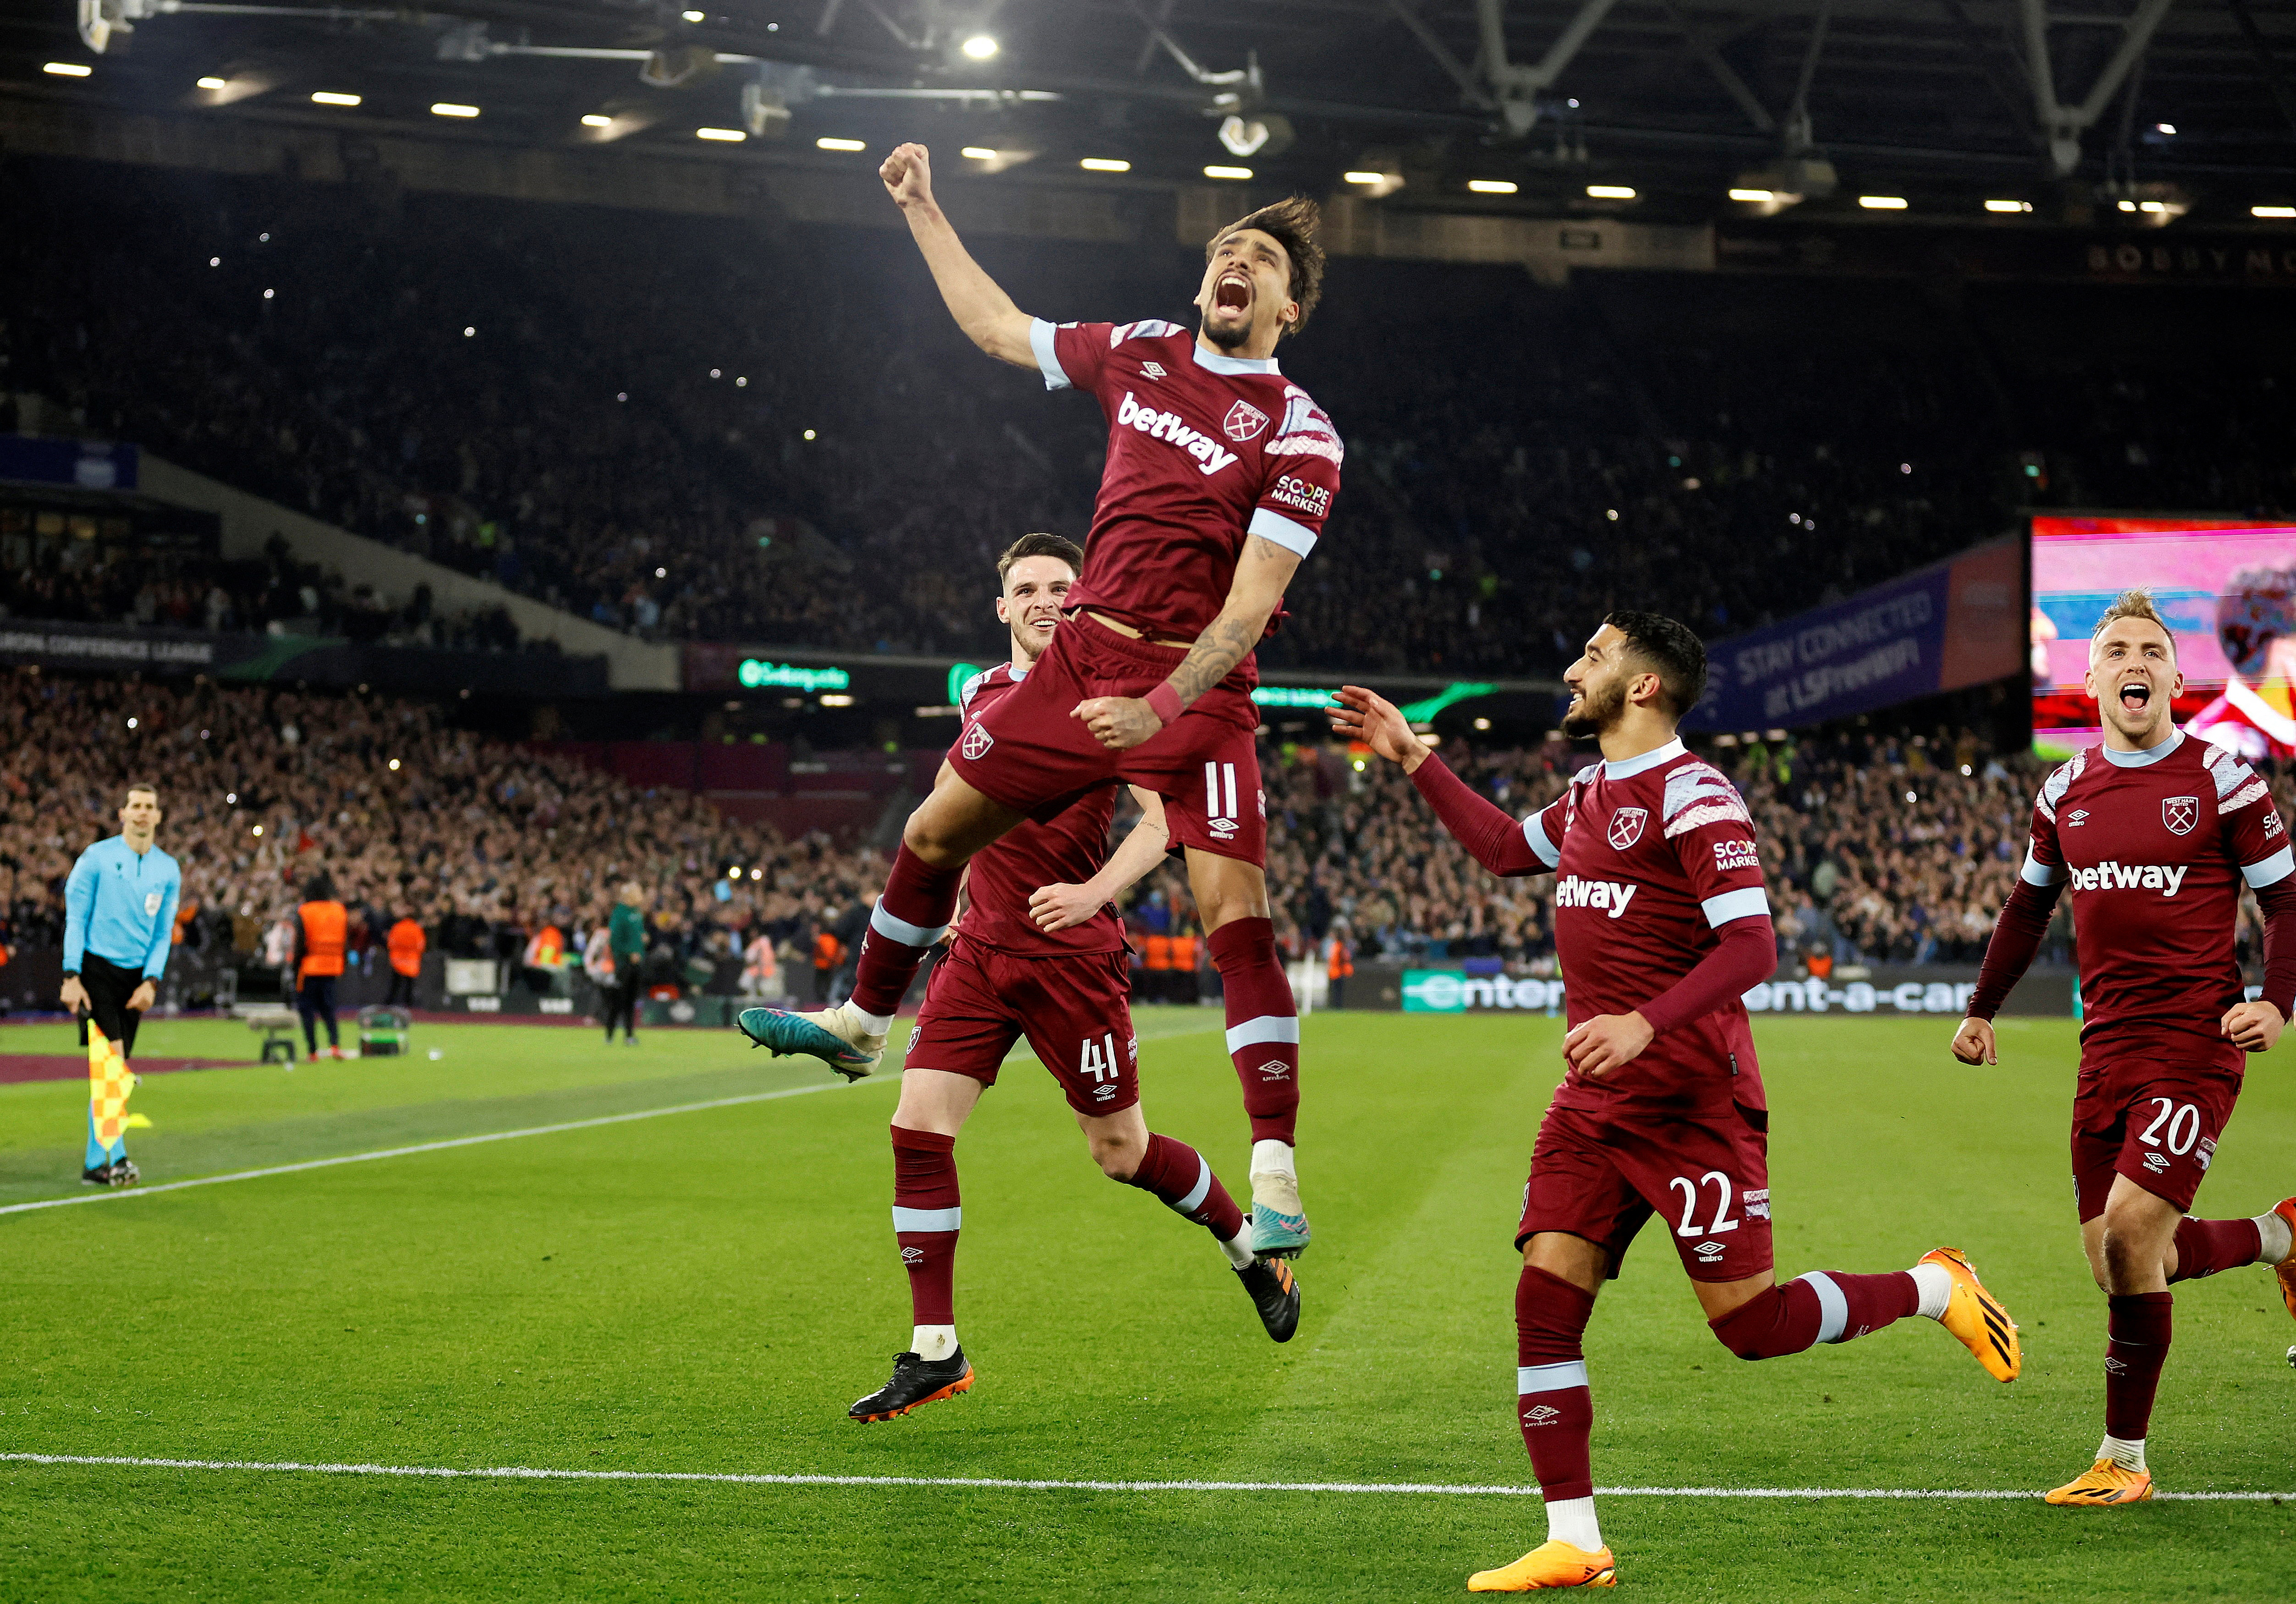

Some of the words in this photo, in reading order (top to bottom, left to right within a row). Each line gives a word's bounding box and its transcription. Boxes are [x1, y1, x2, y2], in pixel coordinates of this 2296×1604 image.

[1118, 391, 1239, 475] betway
[1271, 489, 1324, 516] MARKETS
[1277, 475, 1329, 505] SCOPE
[1205, 761, 1237, 818] 11
[1210, 830, 1234, 840] umbro
[1556, 875, 1637, 918] etway
[2067, 861, 2188, 897] betway
[1080, 1033, 1118, 1082] 41
[1097, 1093, 1115, 1102] umbro
[2138, 1098, 2200, 1155] 20
[2143, 1161, 2163, 1174] umbro
[1670, 1171, 1738, 1237] 22
